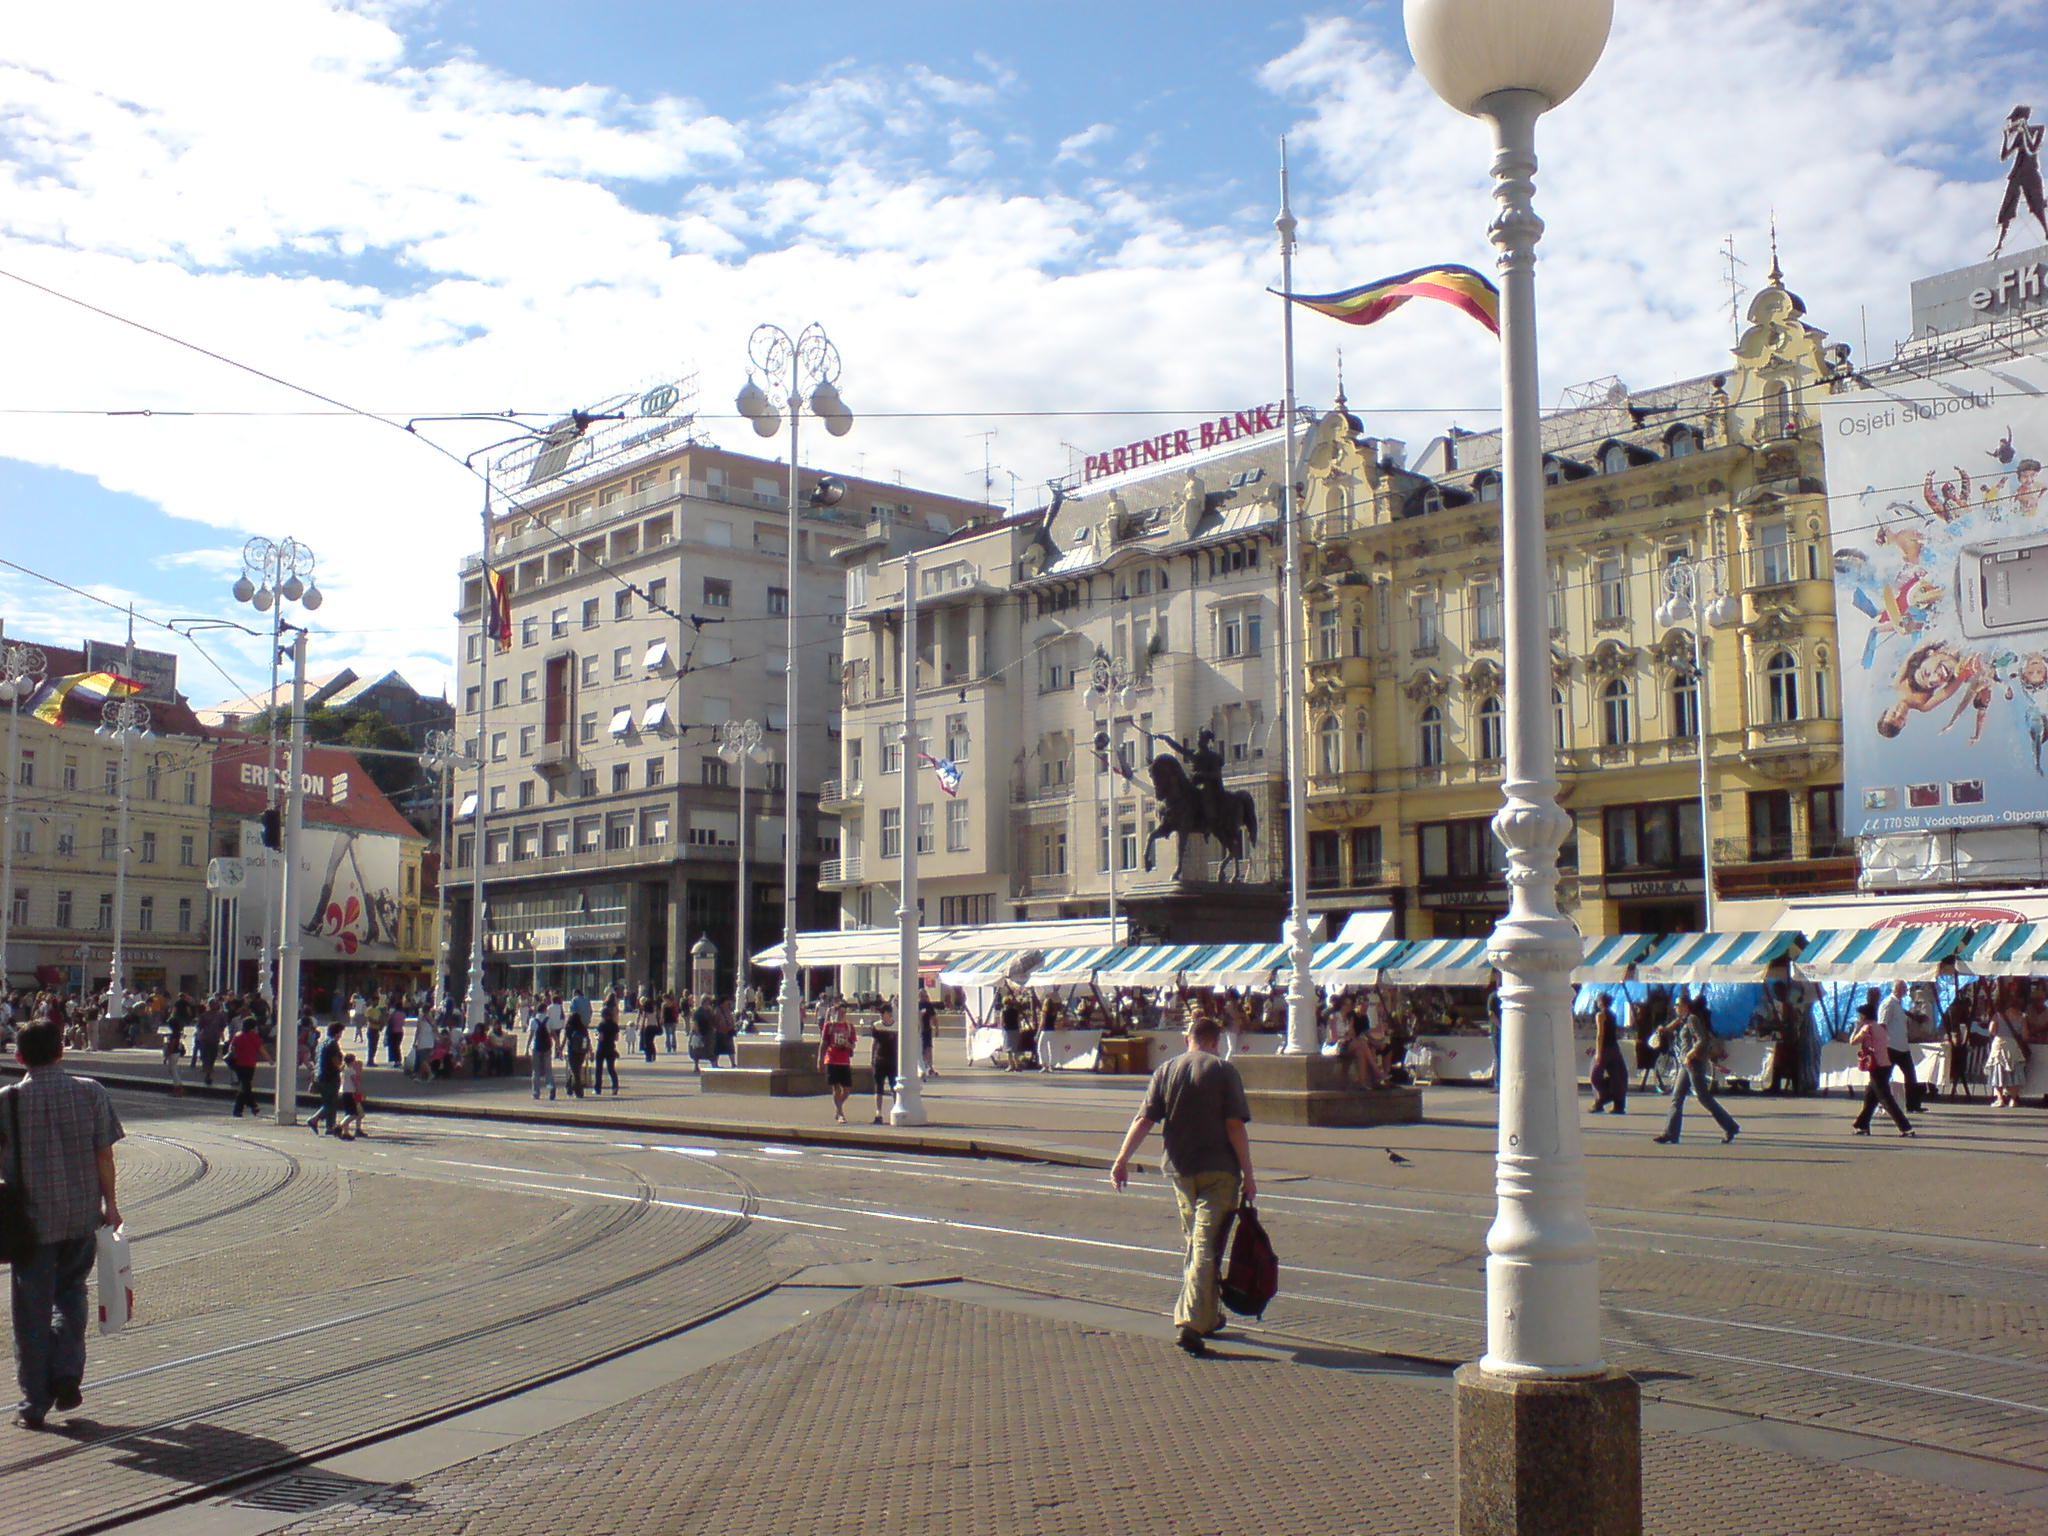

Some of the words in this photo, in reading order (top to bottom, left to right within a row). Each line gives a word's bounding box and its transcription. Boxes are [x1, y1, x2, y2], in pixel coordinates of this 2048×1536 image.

[1839, 407, 1895, 437] Osjeti
[1902, 386, 1995, 423] slobodu!
[1084, 428, 1190, 483] PARTNER
[1884, 816, 1902, 829] 770
[1903, 815, 1921, 828] SW
[1924, 813, 1994, 828] Vodootporan
[1630, 880, 1689, 897] HARMICA
